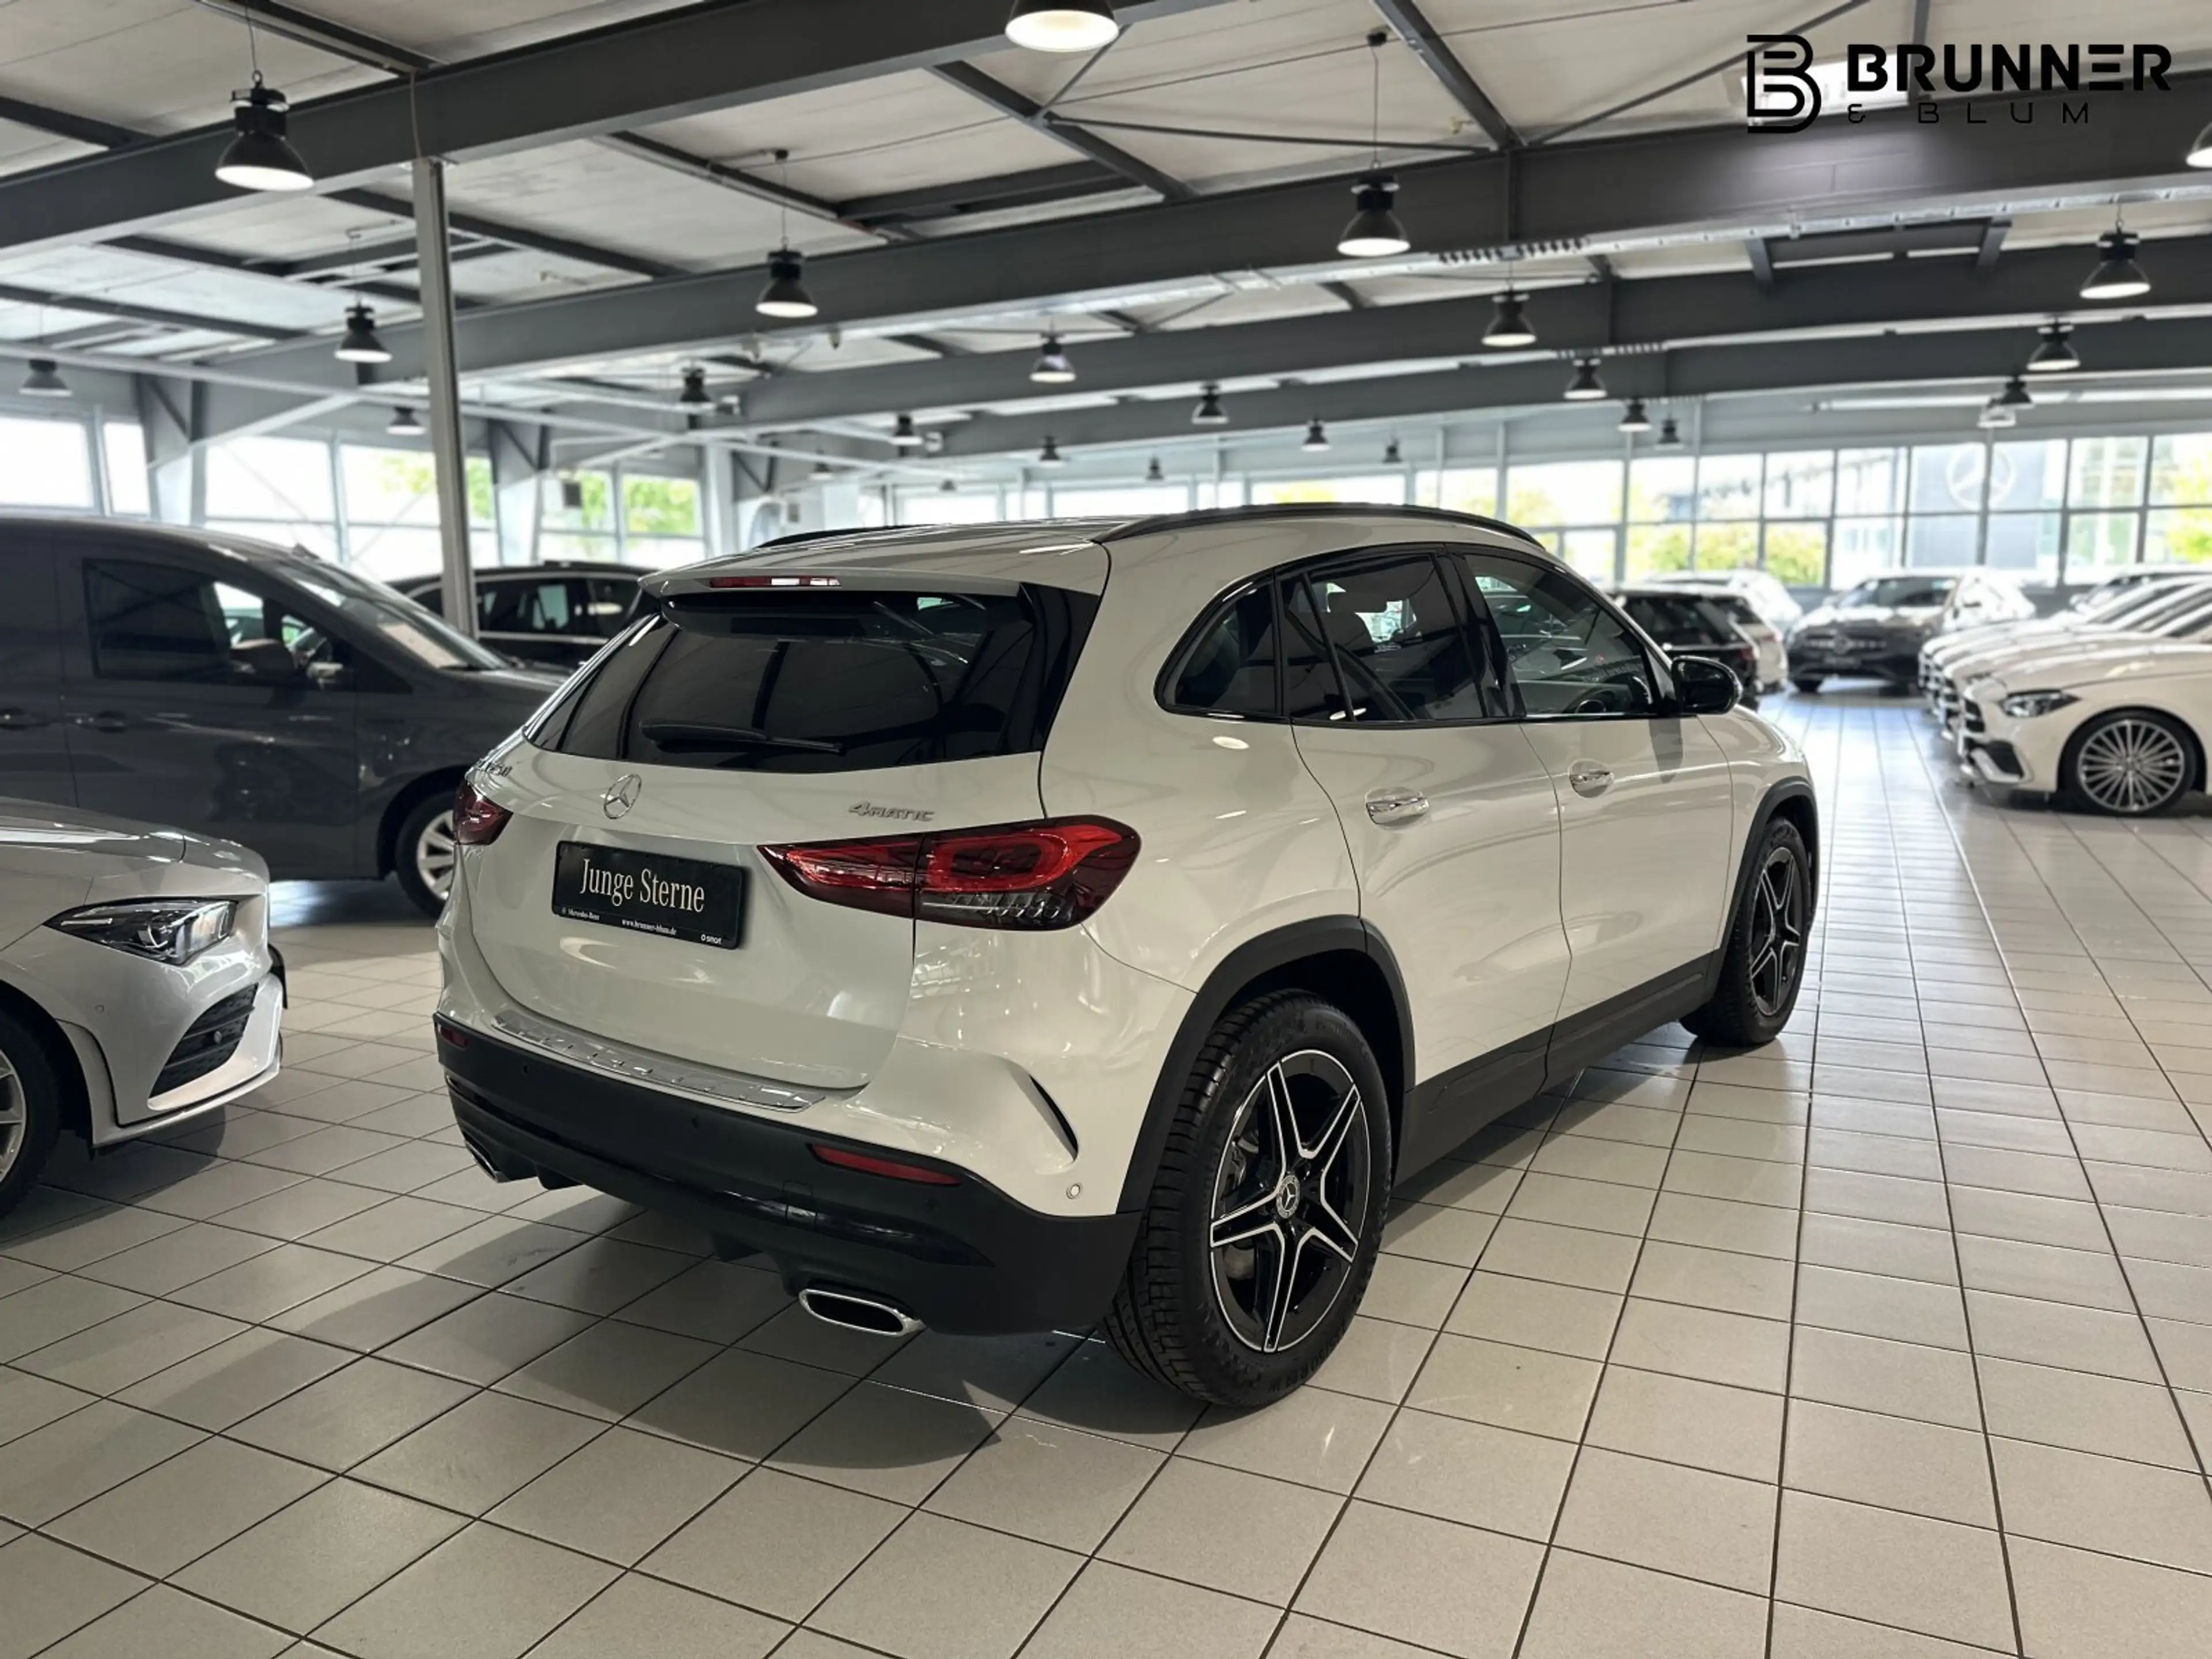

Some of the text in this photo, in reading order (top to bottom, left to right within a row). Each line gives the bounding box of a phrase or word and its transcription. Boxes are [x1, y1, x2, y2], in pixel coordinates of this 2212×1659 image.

[849, 801, 935, 821] 4MATIC
[579, 858, 704, 912] Junge Sterne
